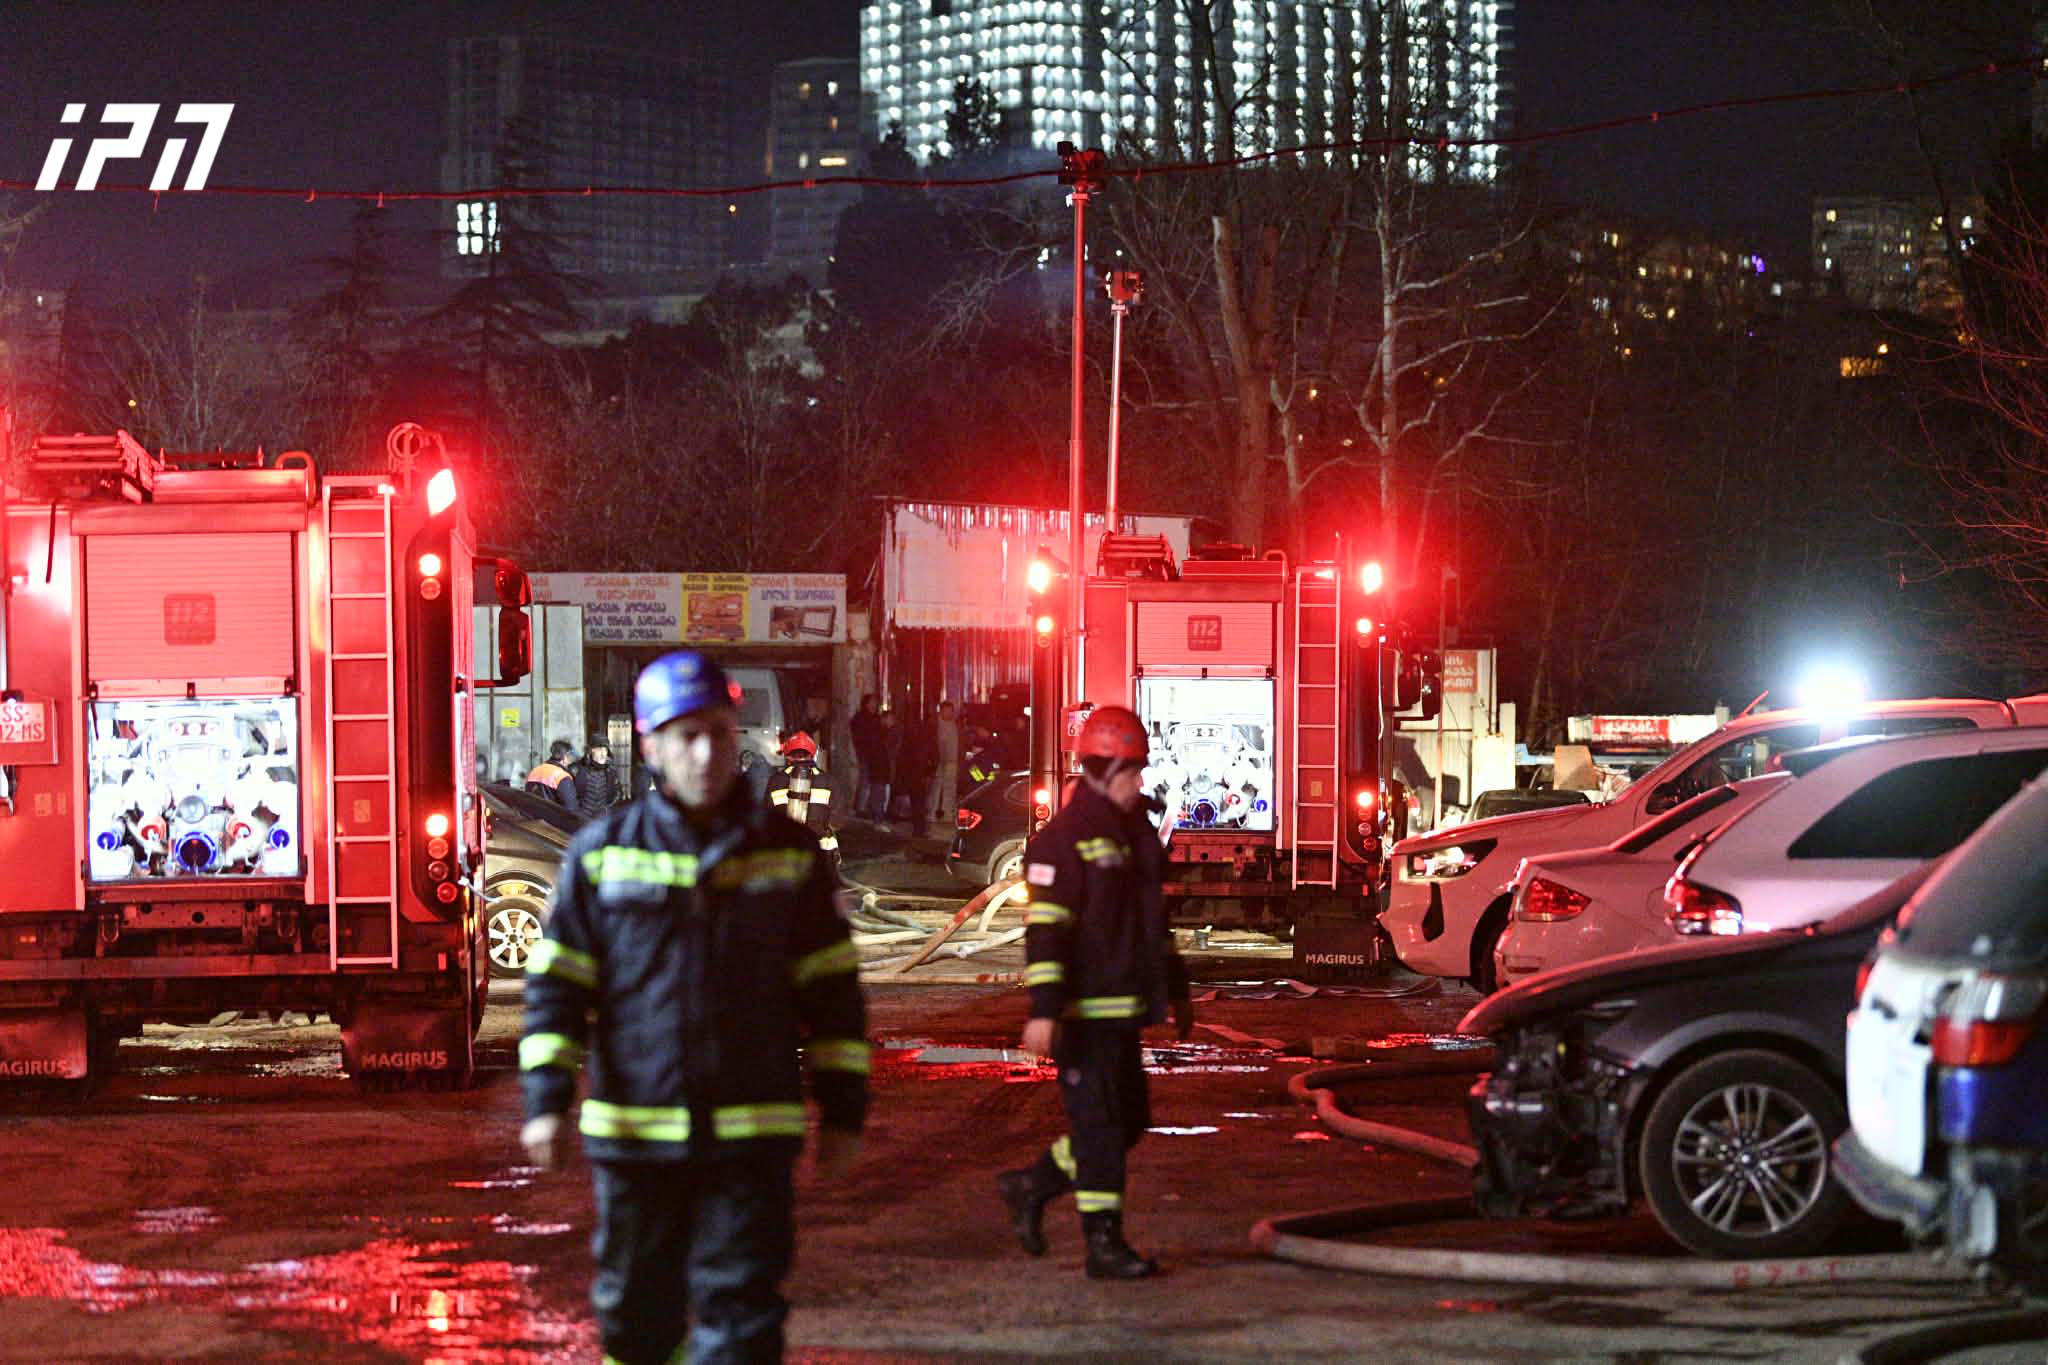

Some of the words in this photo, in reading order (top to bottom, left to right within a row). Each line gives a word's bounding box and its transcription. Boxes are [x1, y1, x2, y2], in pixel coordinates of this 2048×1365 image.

[1192, 620, 1218, 637] 112
[1305, 953, 1364, 964] MAGIRUS
[361, 1050, 448, 1069] MAGIRUS
